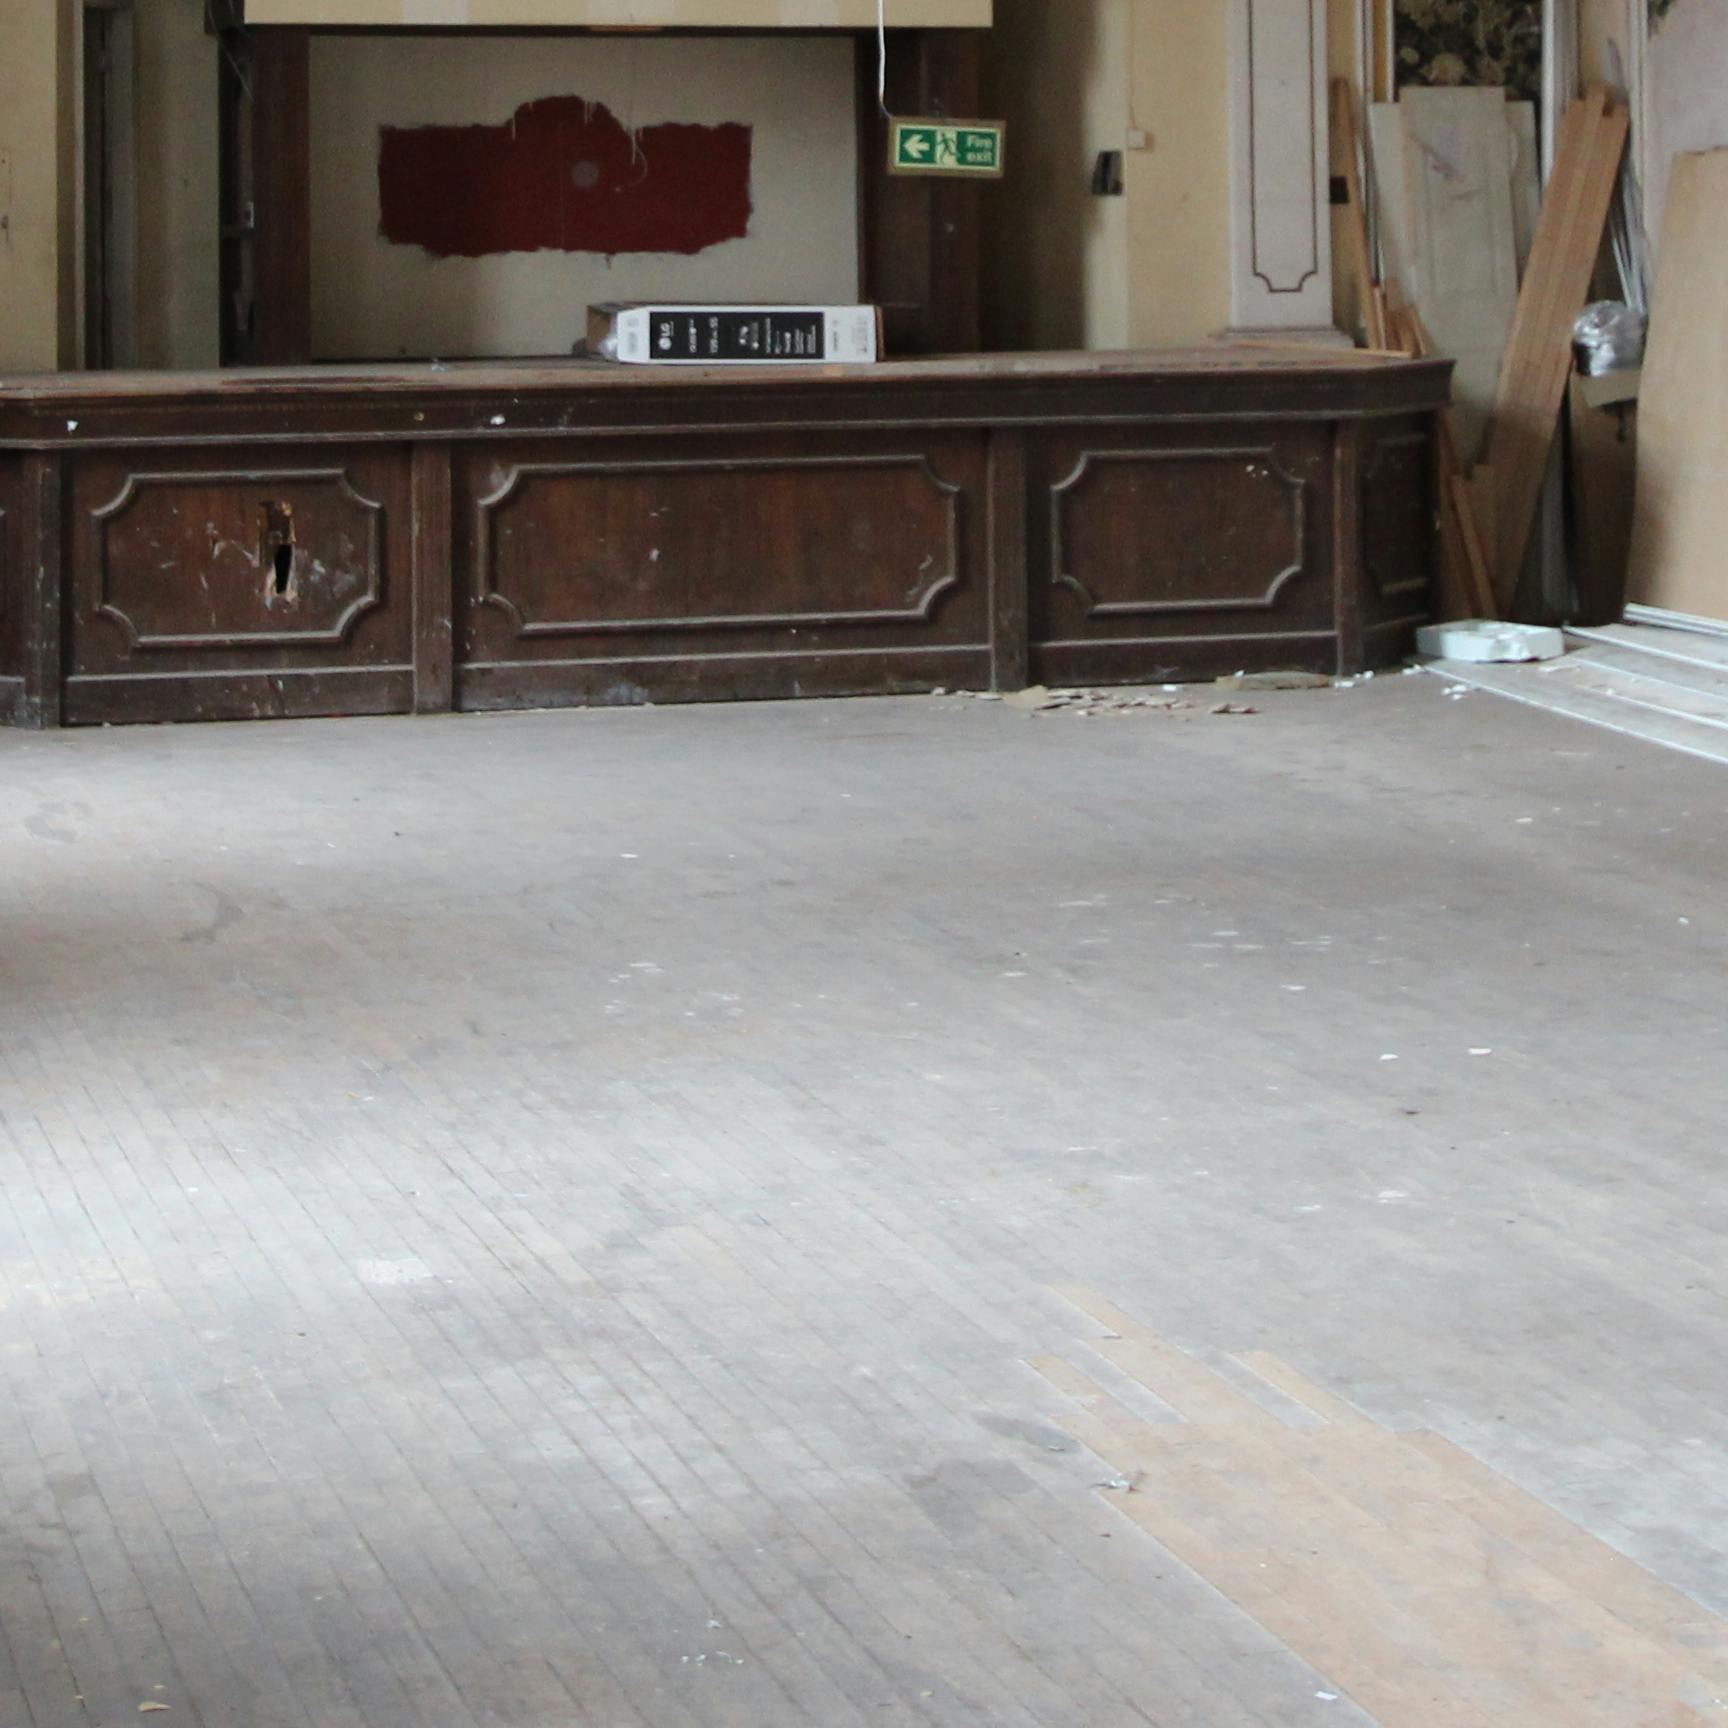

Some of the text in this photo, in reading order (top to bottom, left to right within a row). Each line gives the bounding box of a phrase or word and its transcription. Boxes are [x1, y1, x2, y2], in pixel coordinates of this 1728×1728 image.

[966, 134, 993, 148] Fire
[966, 151, 993, 163] exit
[660, 322, 671, 337] LG
